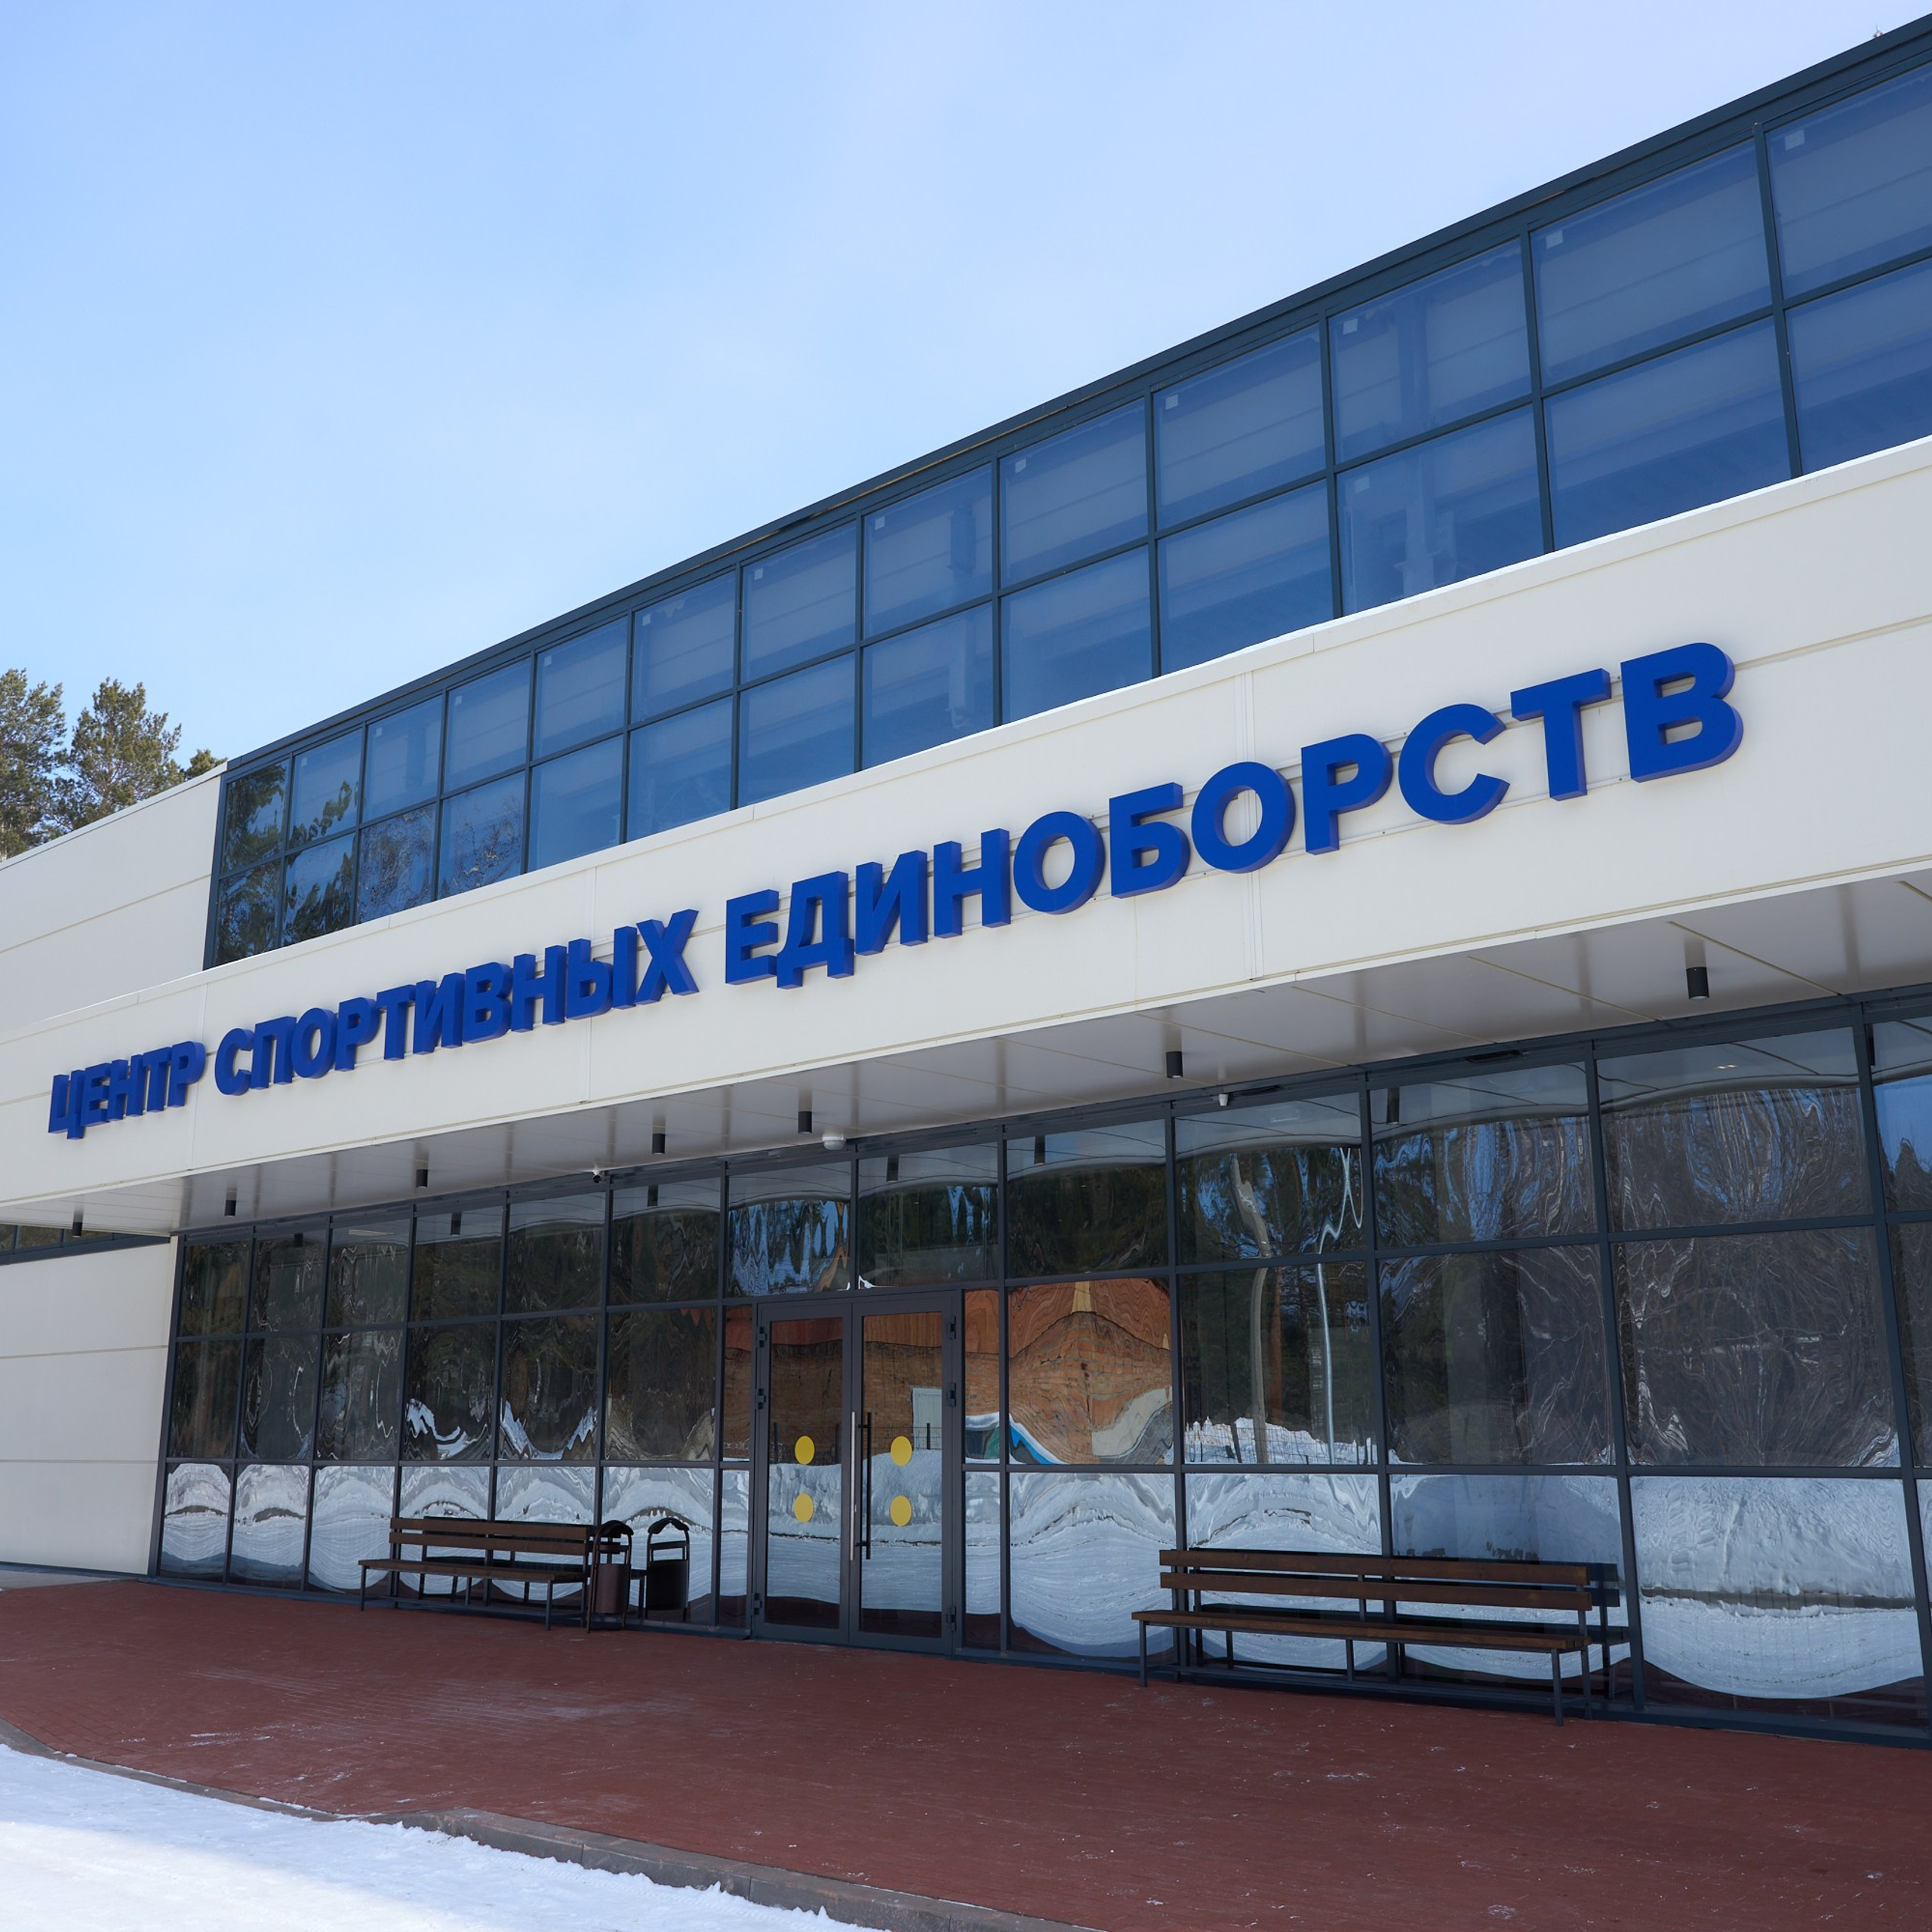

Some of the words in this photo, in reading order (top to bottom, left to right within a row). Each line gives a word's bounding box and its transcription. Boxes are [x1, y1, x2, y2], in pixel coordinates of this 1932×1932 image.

[48, 1041, 206, 1140] ЦЕНТР
[214, 909, 700, 1095] СПОРТИВНЫХ
[725, 642, 1743, 988] ЕДИНОБОРСТВ
